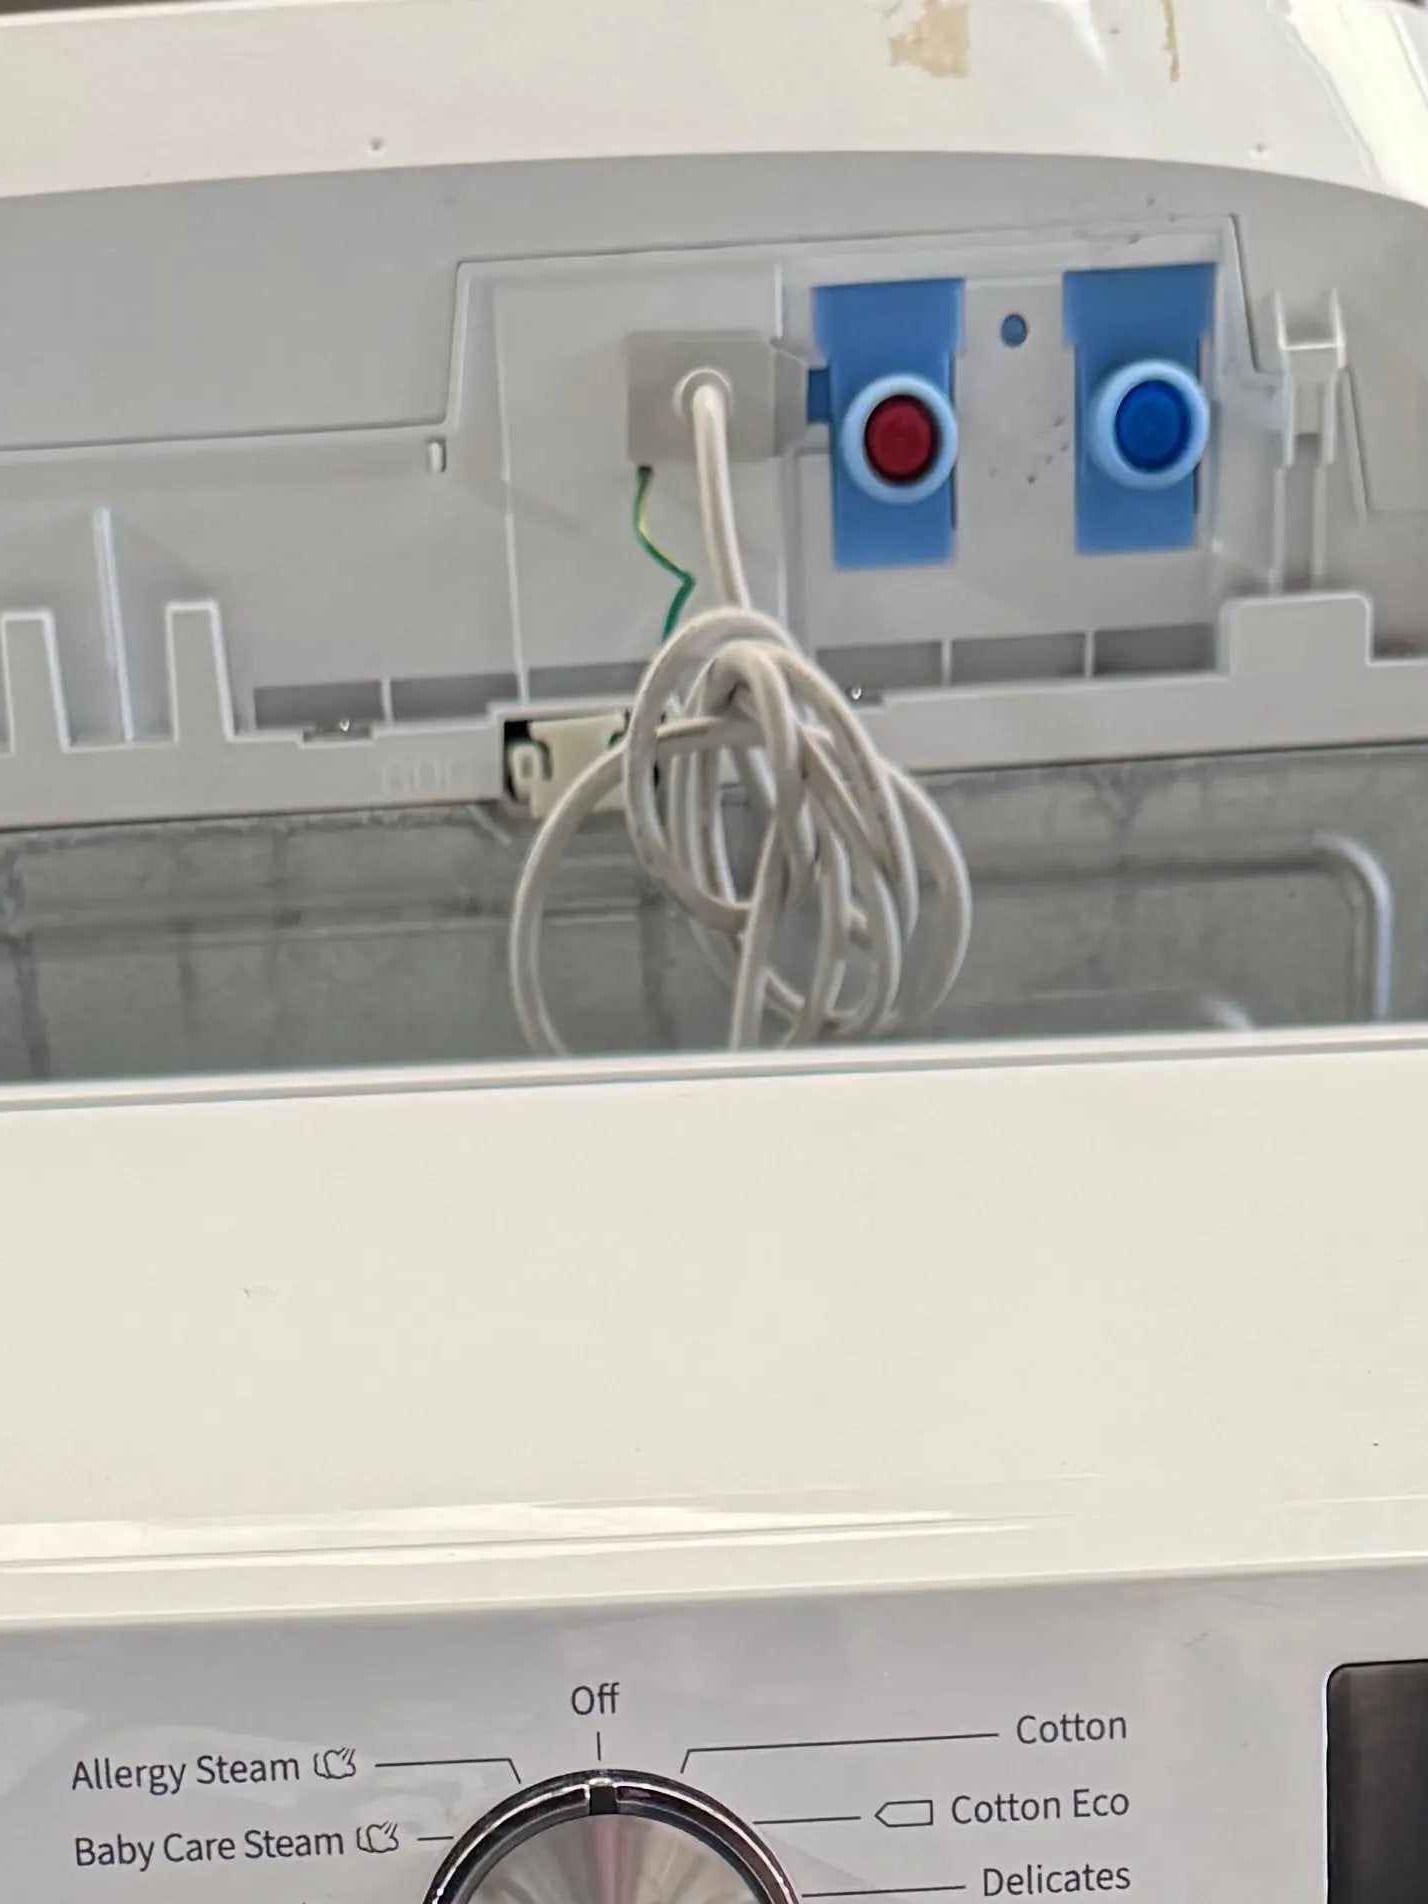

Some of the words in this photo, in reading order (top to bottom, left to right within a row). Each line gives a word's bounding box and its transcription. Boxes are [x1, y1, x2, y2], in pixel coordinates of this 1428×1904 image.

[571, 1682, 620, 1715] Off
[1017, 1713, 1126, 1744] Cotton
[72, 1758, 186, 1795] Allergy
[197, 1755, 299, 1784] Steam
[952, 1794, 1060, 1824] Cotton
[1074, 1789, 1129, 1817] Eco
[75, 1834, 154, 1872] Baby
[164, 1833, 235, 1862] Care
[245, 1830, 343, 1859] Steam
[984, 1864, 1130, 1896] Delicates
